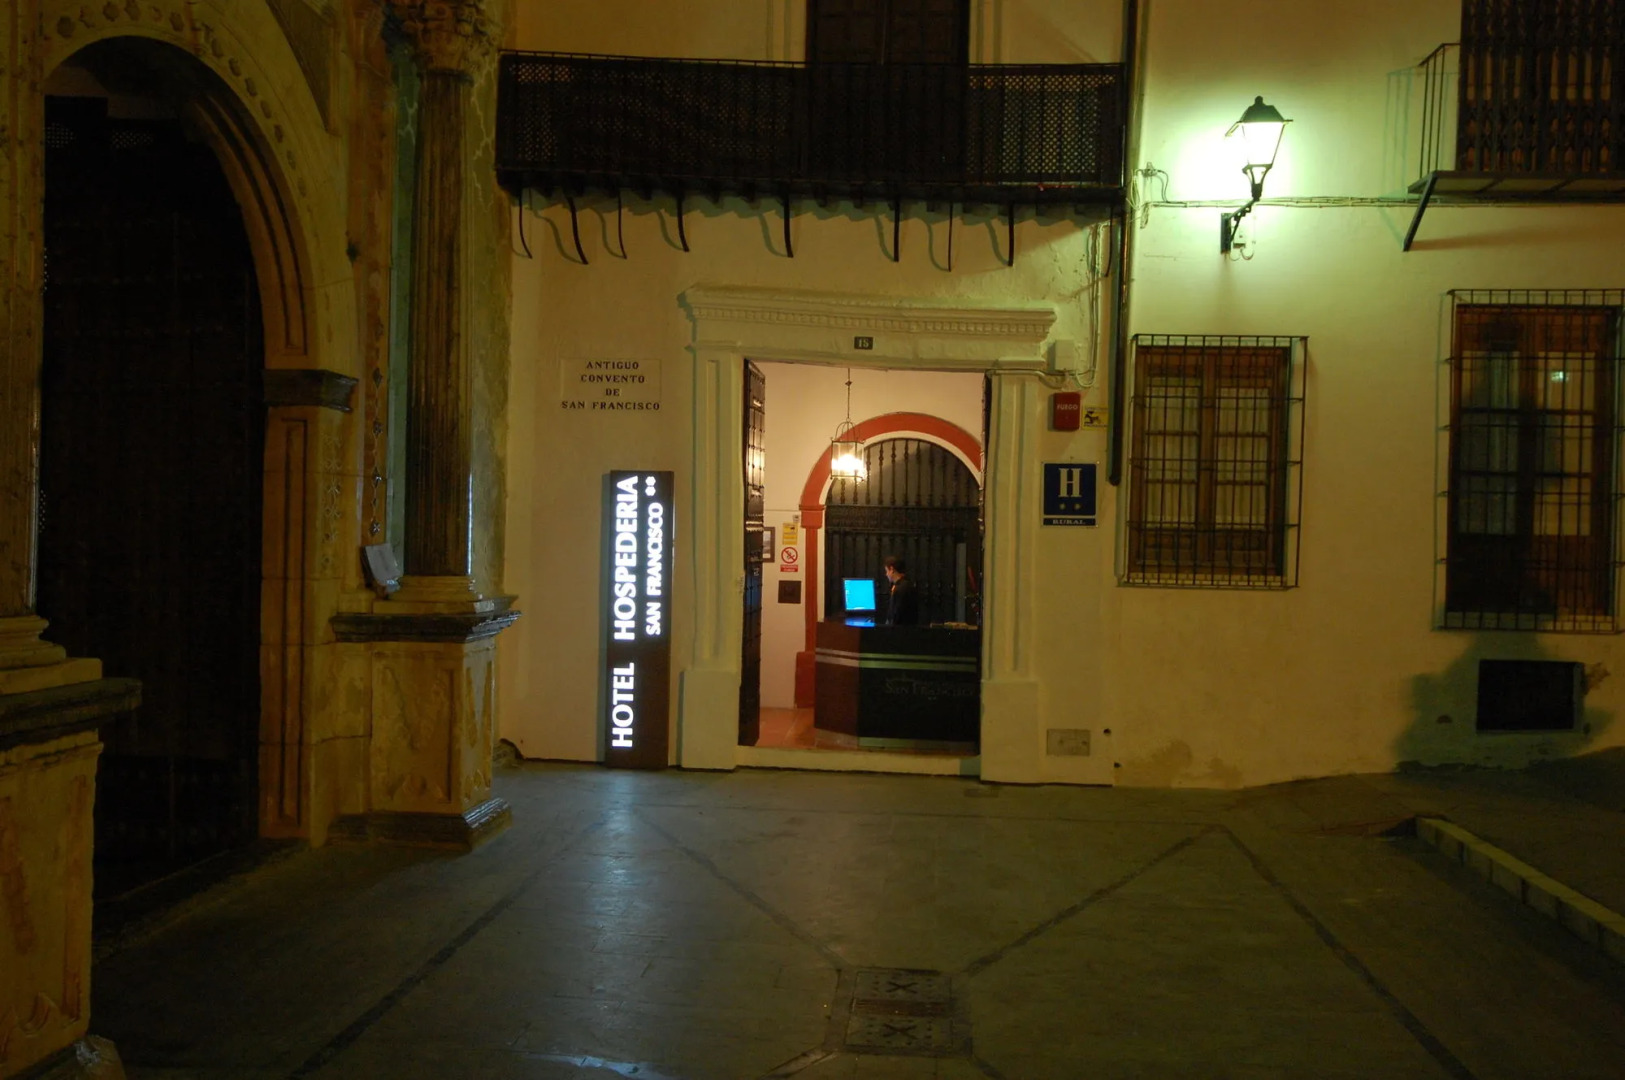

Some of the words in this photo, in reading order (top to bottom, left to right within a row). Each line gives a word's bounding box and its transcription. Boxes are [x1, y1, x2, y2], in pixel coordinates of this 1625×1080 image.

[580, 374, 645, 384] CONVENTO
[586, 361, 640, 370] ANTIGUO
[561, 400, 586, 409] SAN
[592, 401, 660, 411] FRANCISCO
[605, 388, 620, 397] DE
[1058, 467, 1082, 498] H
[613, 475, 639, 641] HOSPEDERIA
[646, 502, 664, 597] FRANCISCO
[645, 601, 661, 636] SAN
[611, 661, 635, 749] HOTEL
